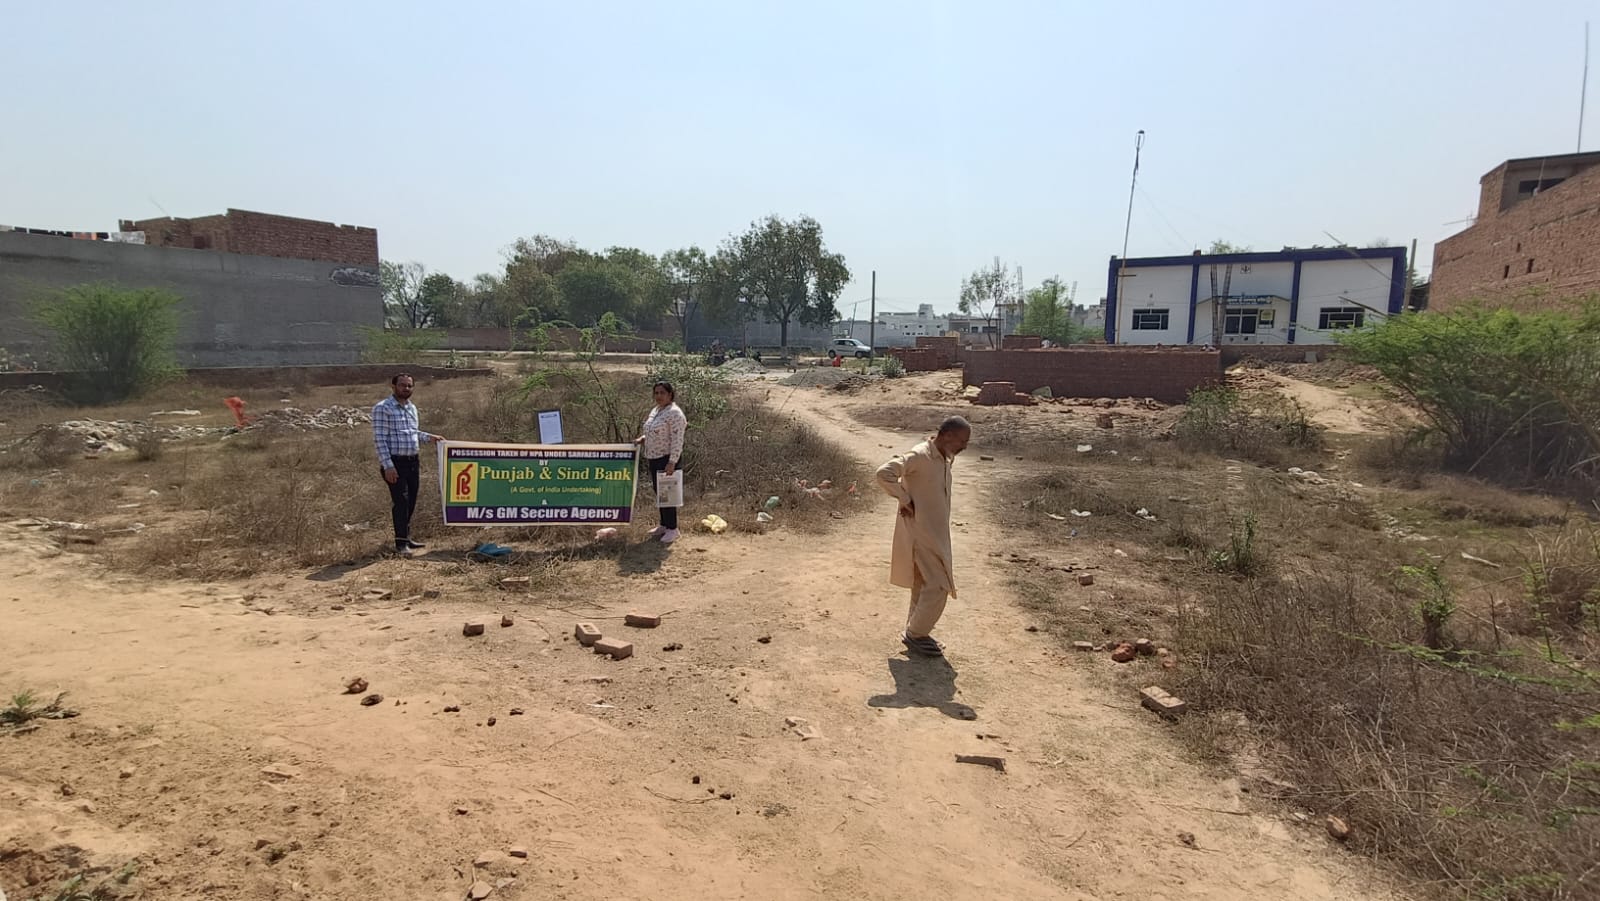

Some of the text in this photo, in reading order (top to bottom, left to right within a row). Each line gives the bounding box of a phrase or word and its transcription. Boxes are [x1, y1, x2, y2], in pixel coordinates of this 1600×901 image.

[480, 466, 631, 483] Punjab & Sind Bank
[467, 507, 619, 519] M/s GM Secure Agency
